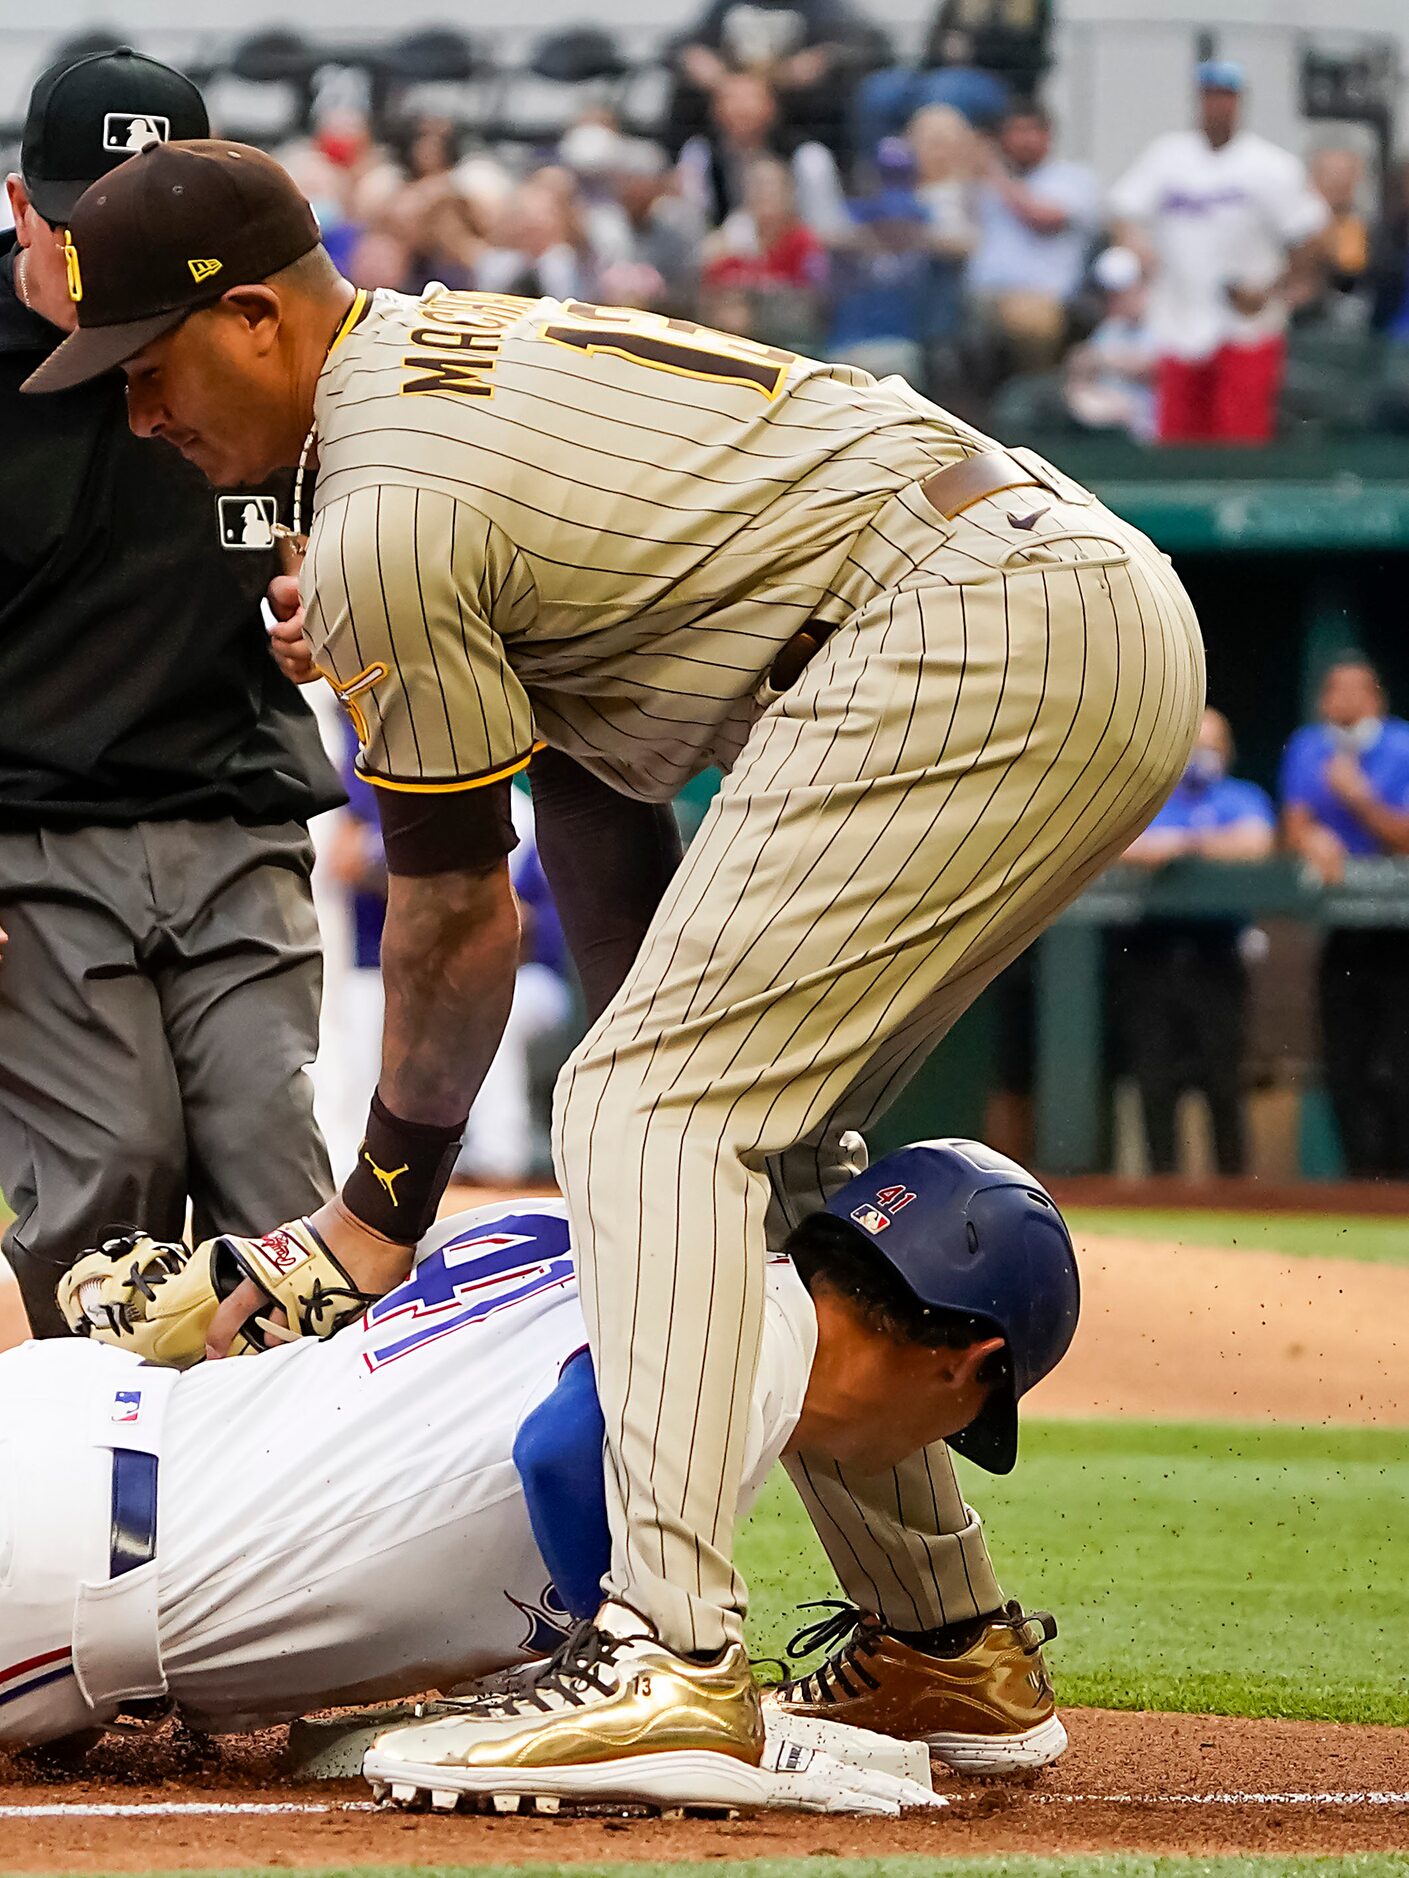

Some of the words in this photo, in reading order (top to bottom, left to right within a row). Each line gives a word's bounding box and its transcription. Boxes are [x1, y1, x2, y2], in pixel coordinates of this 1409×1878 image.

[876, 1184, 917, 1216] 41
[363, 1213, 576, 1374] 41
[632, 1674, 652, 1697] 13
